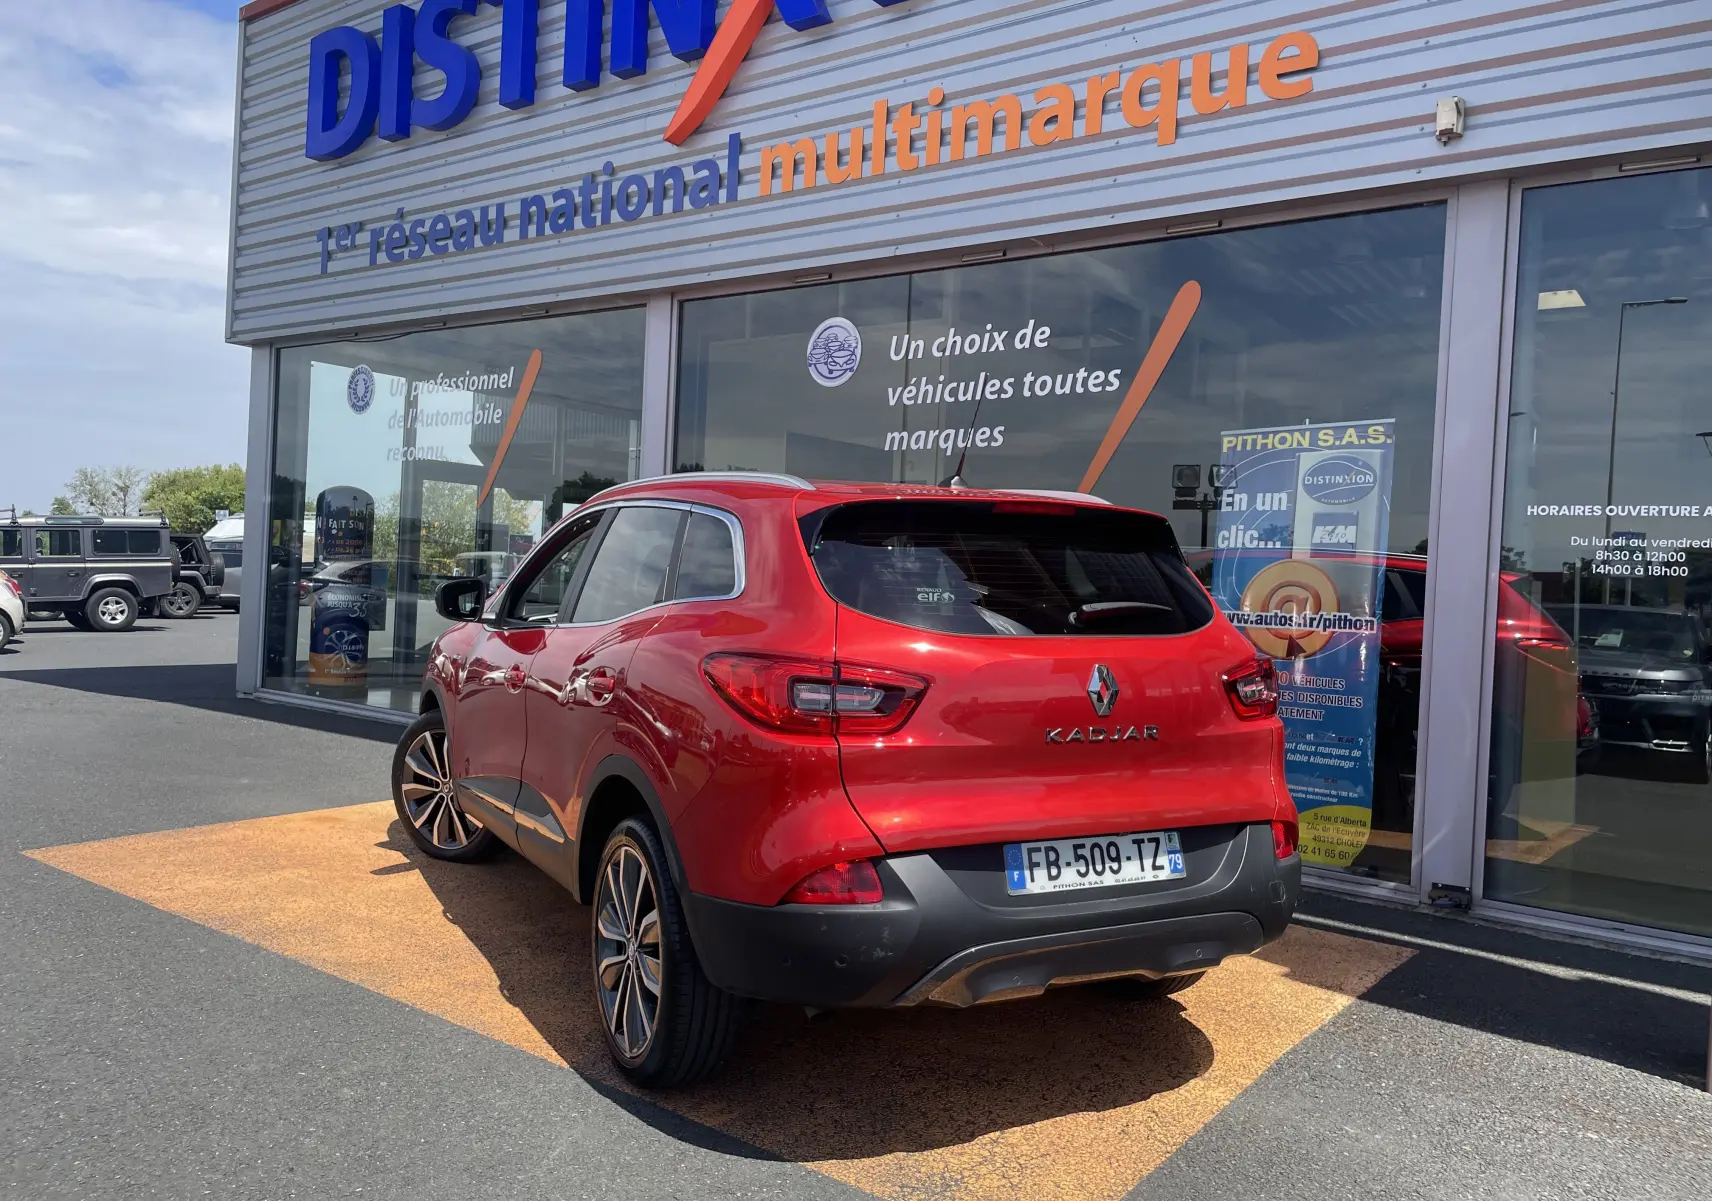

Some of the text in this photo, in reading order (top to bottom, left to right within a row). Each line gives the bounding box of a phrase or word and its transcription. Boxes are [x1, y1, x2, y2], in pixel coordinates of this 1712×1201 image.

[369, 202, 505, 266] réseau
[519, 132, 741, 240] national
[759, 31, 1320, 195] multimarque
[890, 319, 1051, 361] Un choix de
[389, 366, 514, 400] Un professionnel
[887, 367, 1122, 406] véhicules toutes
[388, 406, 503, 430] de l'Automobile
[884, 425, 1005, 456] marques
[1222, 426, 1393, 453] PITHON S.A.S.
[1304, 470, 1374, 486] DISTINXION
[1221, 489, 1288, 512] En un
[1526, 505, 1602, 517] HORAIRES
[1606, 505, 1699, 517] OUVERTURE
[1217, 525, 1282, 548] clic...
[1570, 536, 1588, 546] Du
[1592, 536, 1626, 547] lundi
[1629, 539, 1647, 547] au
[1596, 551, 1686, 562] 8h30 à 12h00
[1591, 564, 1689, 577] 14h00 à 18h00
[917, 592, 940, 602] elf
[1291, 675, 1345, 690] VÉHICULES
[1298, 693, 1363, 708] DISPONIBLES
[1044, 725, 1159, 745] KADJAR
[1286, 753, 1308, 762] faible
[1297, 742, 1315, 752] deux
[1317, 746, 1350, 756] marques
[1351, 749, 1362, 757] de
[1334, 816, 1367, 827] d'Alberta
[1026, 836, 1165, 883] FB-509-TZ
[1297, 844, 1308, 853] 02
[1311, 847, 1321, 856] 41
[1324, 849, 1335, 858] 65
[1338, 851, 1350, 860] 60
[1168, 853, 1183, 869] 79
[1013, 871, 1020, 882] F
[1052, 881, 1086, 890] PITHON
[1088, 879, 1105, 887] SAS
